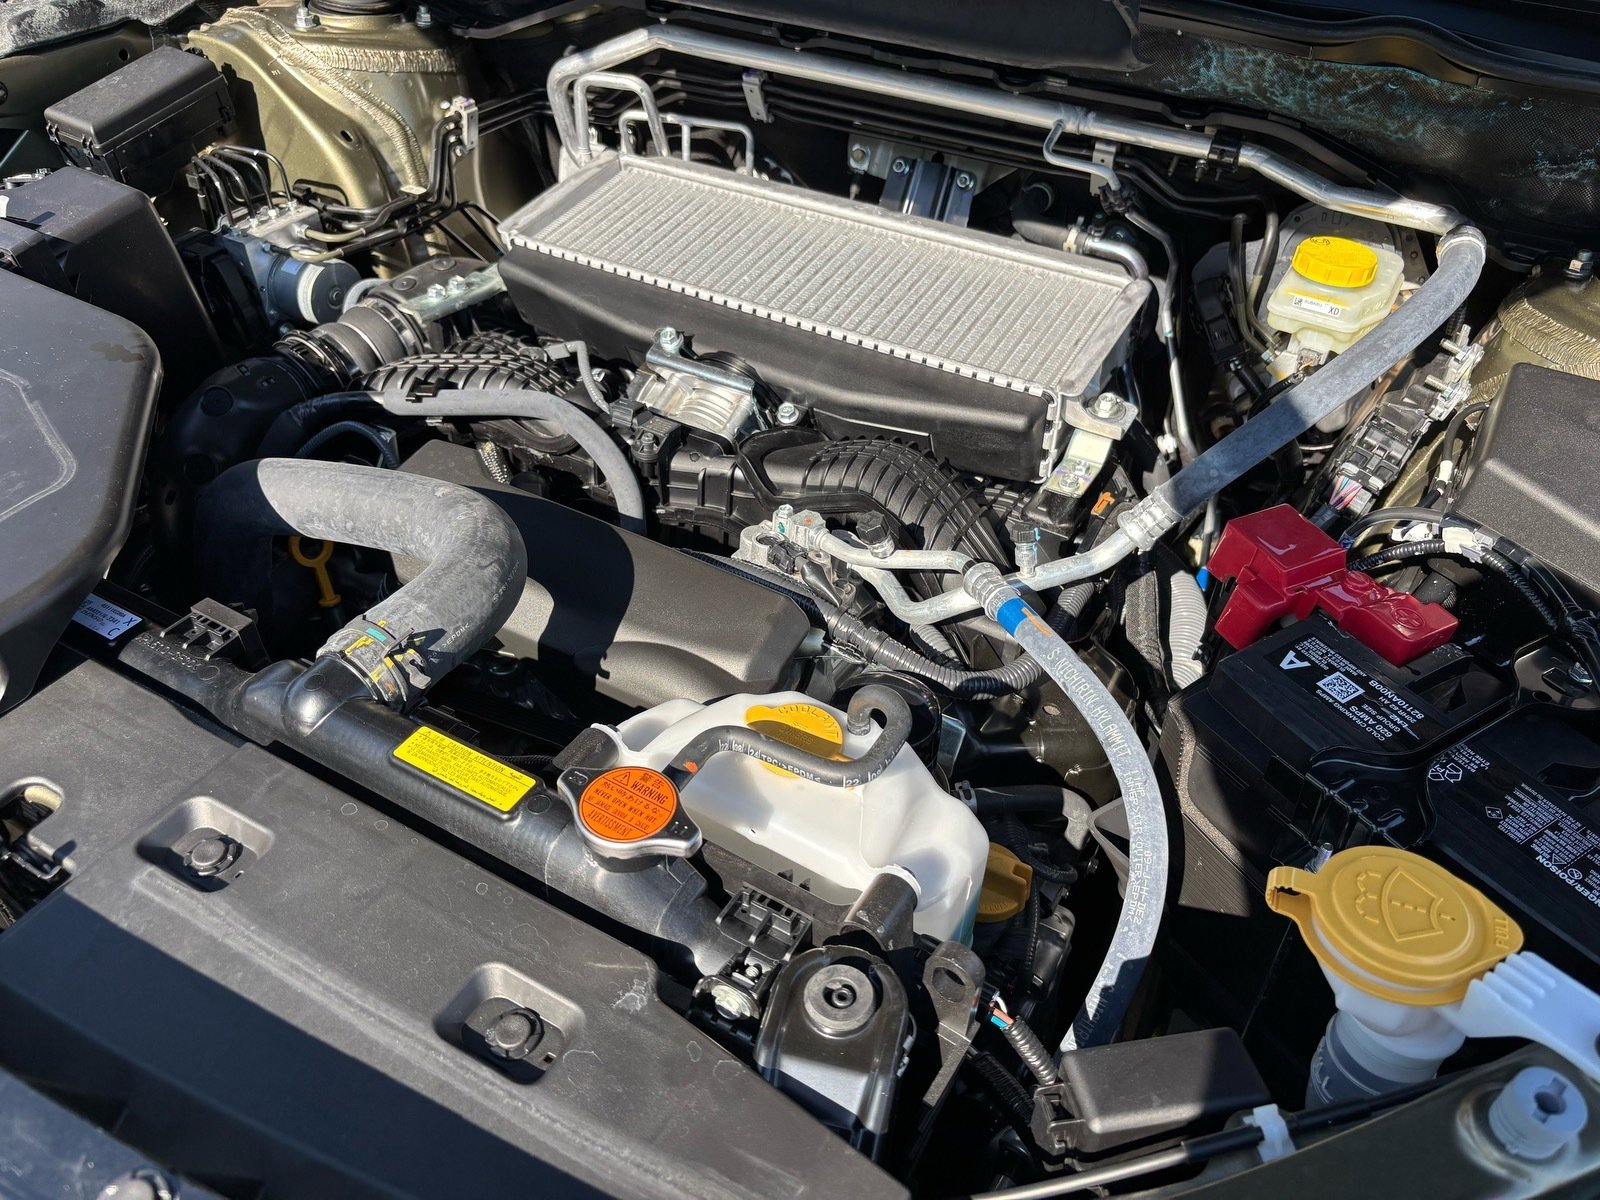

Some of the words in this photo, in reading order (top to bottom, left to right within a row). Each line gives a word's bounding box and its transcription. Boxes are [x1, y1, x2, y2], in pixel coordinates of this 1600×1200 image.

[1328, 306, 1340, 316] XD
[123, 616, 138, 627] X
[107, 627, 121, 637] C
[1279, 649, 1311, 670] A
[1314, 688, 1335, 704] AMPS
[1369, 679, 1424, 720] 82110AN00B
[1378, 695, 1390, 704] AH
[1332, 701, 1368, 728] CRANKING
[1348, 704, 1378, 726] AMPS
[1361, 703, 1378, 716] SIZE
[1365, 725, 1386, 741] COLD
[1374, 723, 1393, 738] 620
[1375, 713, 1401, 733] GROUP
[446, 741, 473, 757] CAUTION
[473, 754, 506, 773] ATTENTION
[593, 787, 612, 800] NEVER
[611, 797, 628, 808] OPEN
[627, 805, 645, 817] WHEN
[628, 780, 669, 805] WARNING
[1495, 918, 1510, 949] PULL
